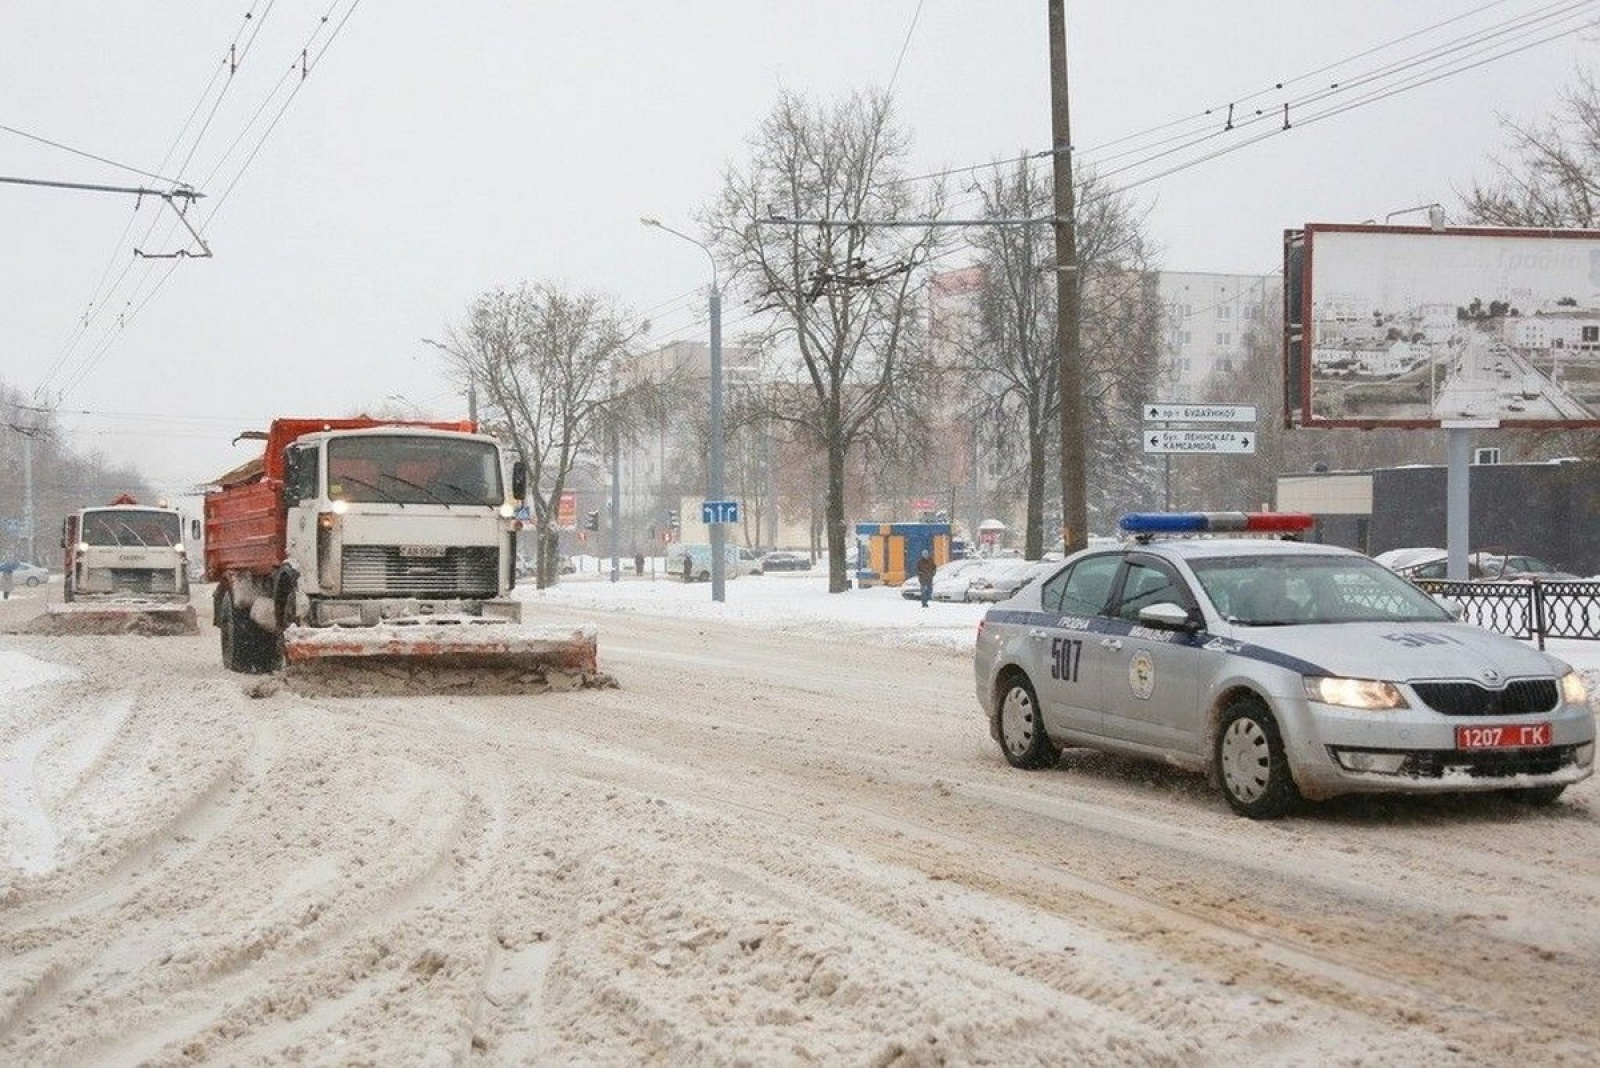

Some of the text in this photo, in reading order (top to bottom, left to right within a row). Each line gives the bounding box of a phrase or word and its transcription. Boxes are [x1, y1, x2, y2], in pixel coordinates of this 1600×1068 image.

[1051, 637, 1083, 682] 507
[1463, 727, 1544, 746] 1207 ГК
